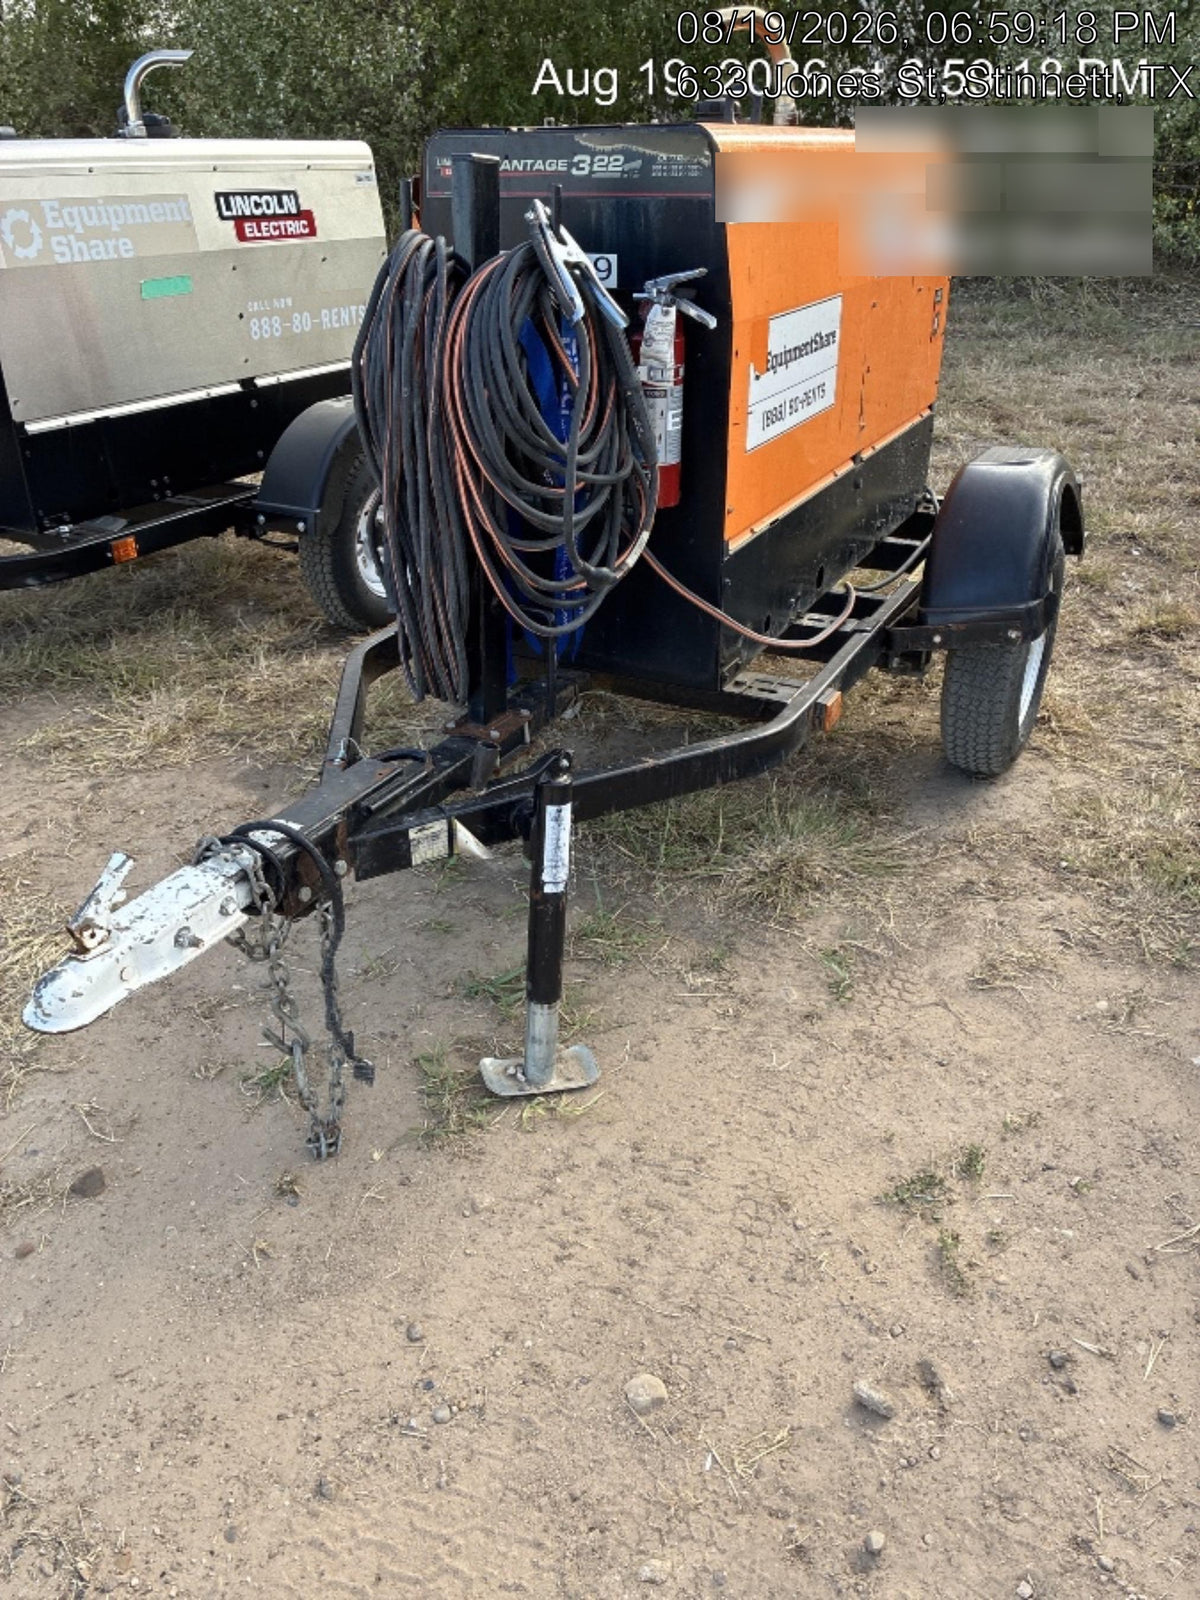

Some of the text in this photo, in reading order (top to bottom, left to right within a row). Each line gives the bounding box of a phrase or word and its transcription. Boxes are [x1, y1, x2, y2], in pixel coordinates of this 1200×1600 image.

[570, 153, 625, 175] 322
[42, 198, 191, 233] Equipment
[218, 193, 299, 217] LINCOLN
[243, 219, 311, 238] ELECTRIC
[54, 235, 135, 264] Share
